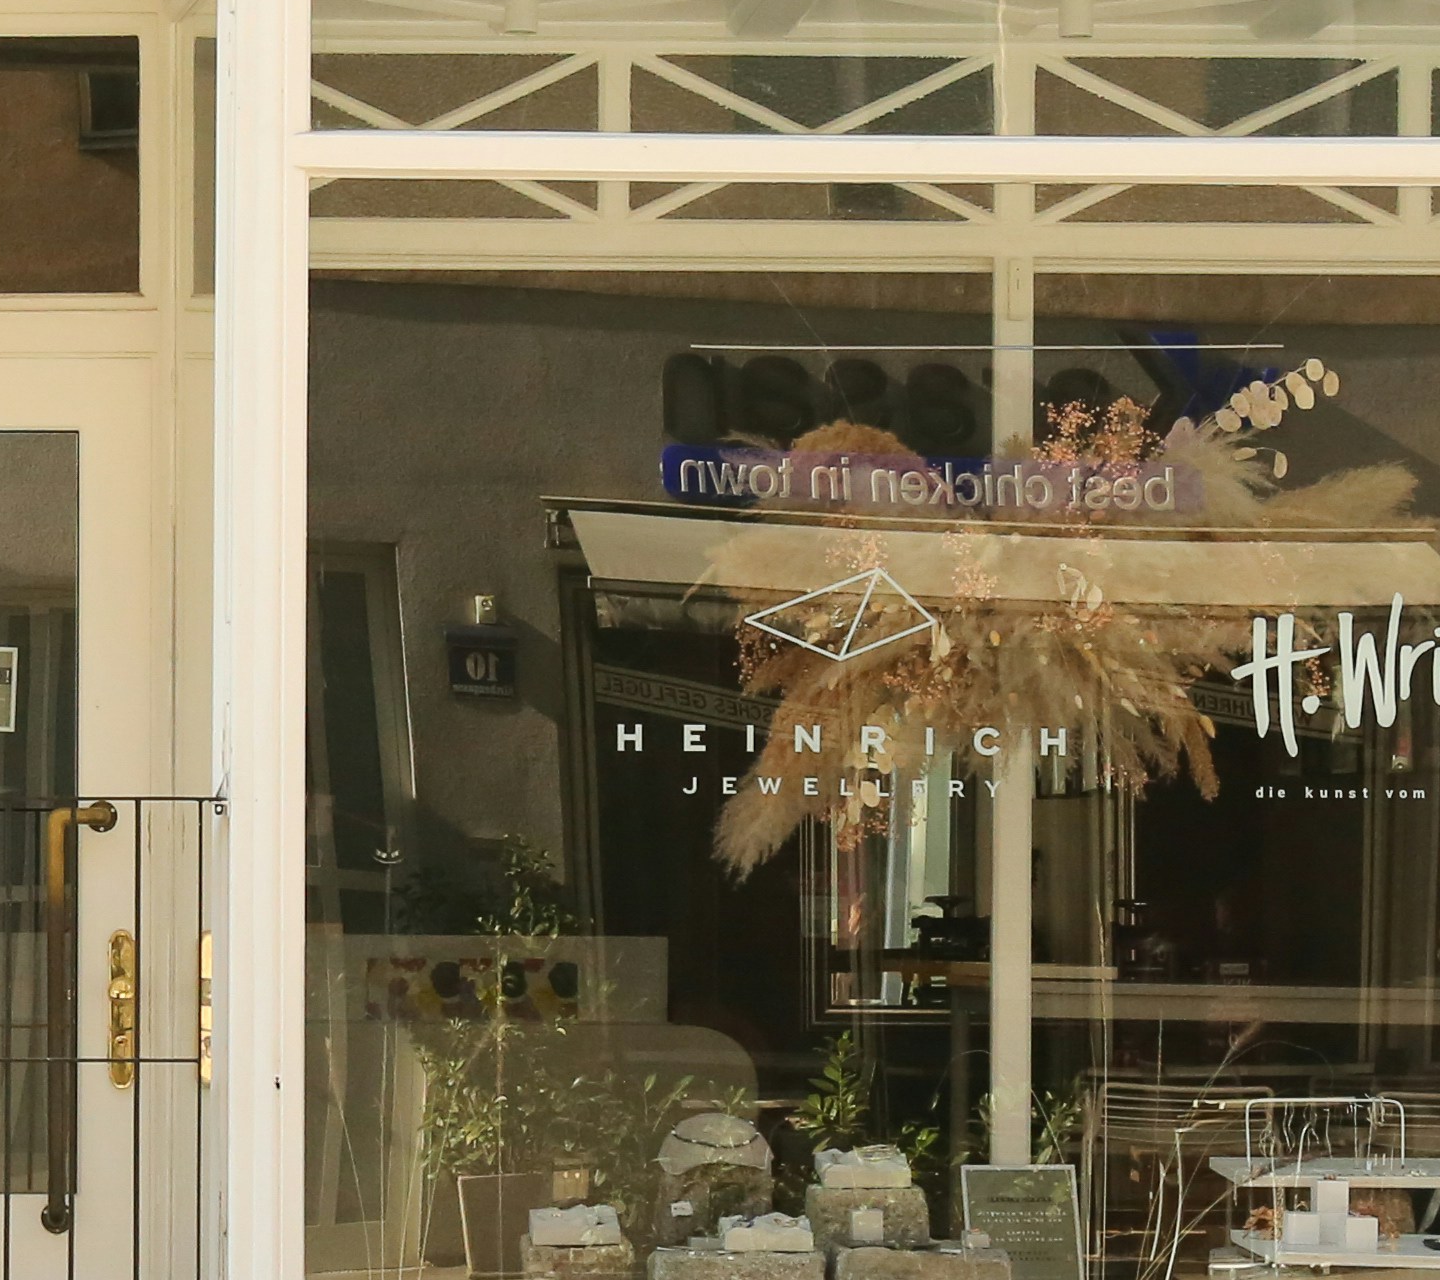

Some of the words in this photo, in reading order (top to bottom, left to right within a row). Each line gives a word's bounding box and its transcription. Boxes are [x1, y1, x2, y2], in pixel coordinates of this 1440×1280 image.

[1229, 611, 1331, 758] H.
[615, 723, 1067, 757] HEINRICH
[681, 775, 1004, 800] JEWELLERY
[1255, 786, 1286, 800] die
[1304, 786, 1369, 800] kunst
[1385, 788, 1426, 800] vom
